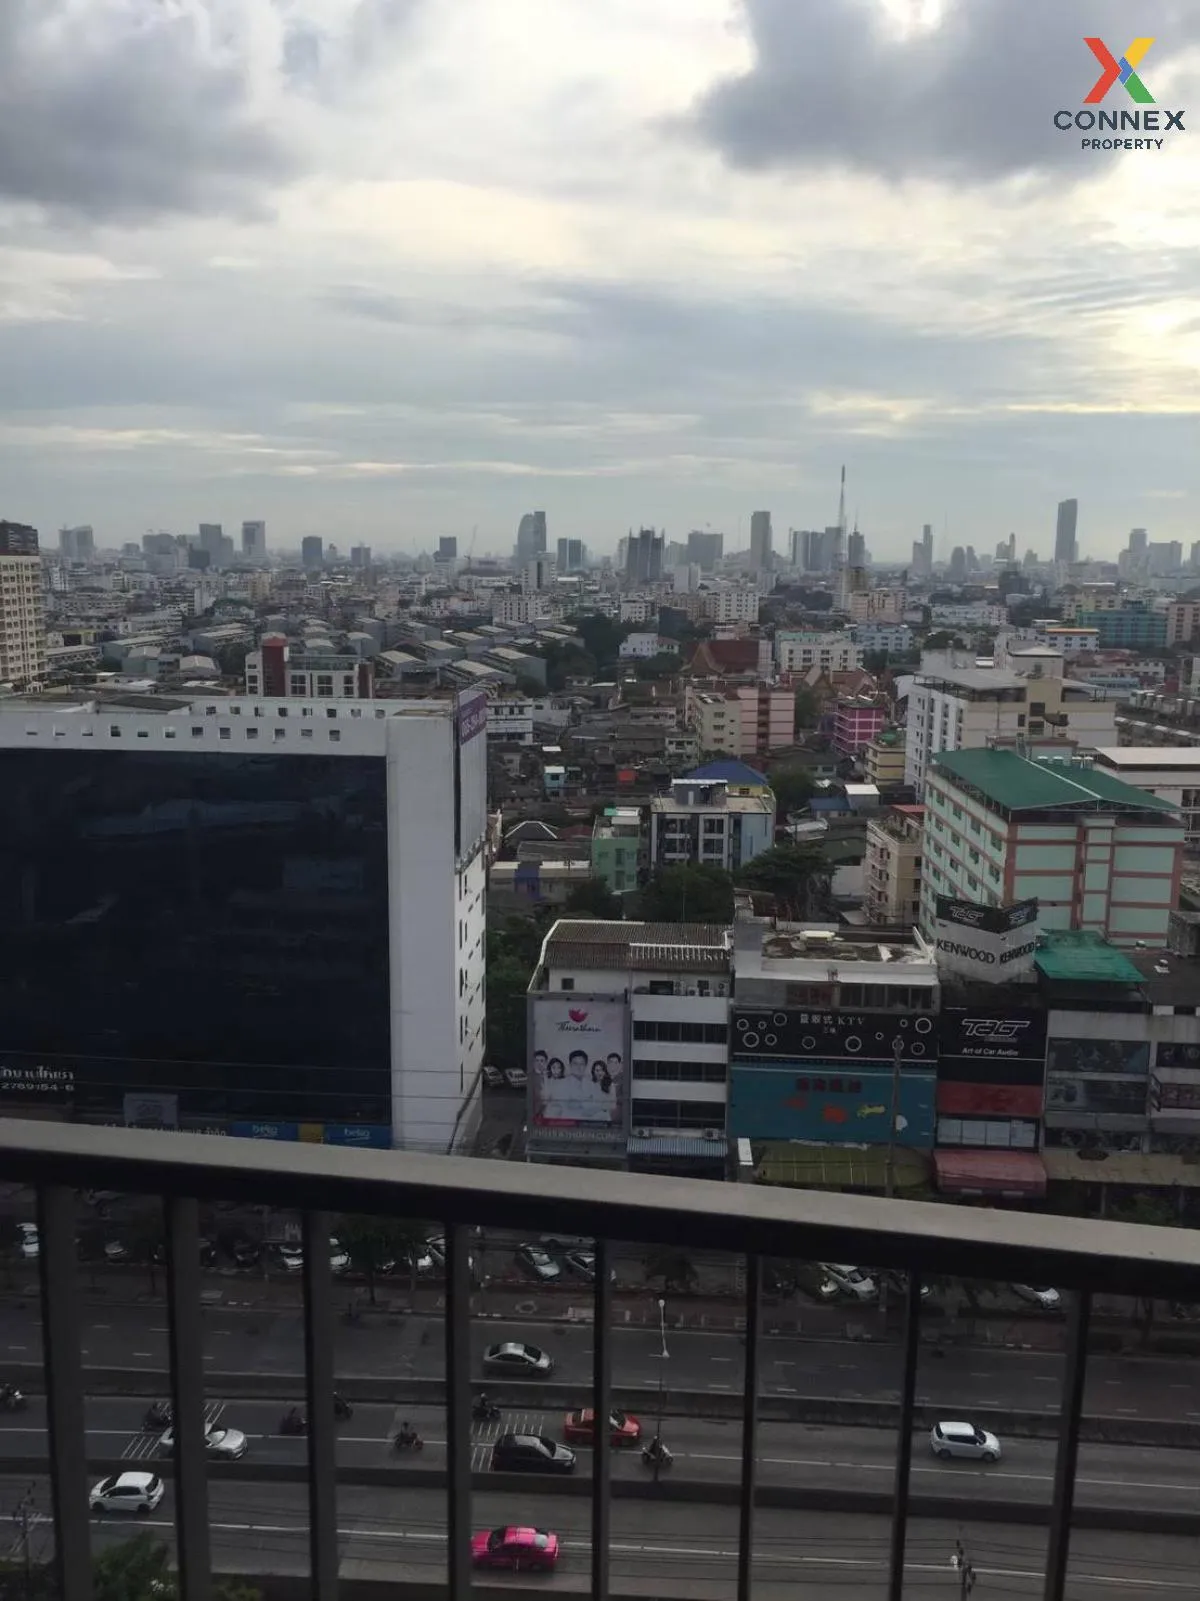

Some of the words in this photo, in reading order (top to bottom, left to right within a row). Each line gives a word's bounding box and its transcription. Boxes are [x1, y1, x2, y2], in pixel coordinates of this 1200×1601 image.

[937, 938, 996, 965] KENWOOD
[962, 1047, 973, 1055] Art
[984, 1048, 996, 1056] Car
[997, 1049, 1019, 1058] Audio
